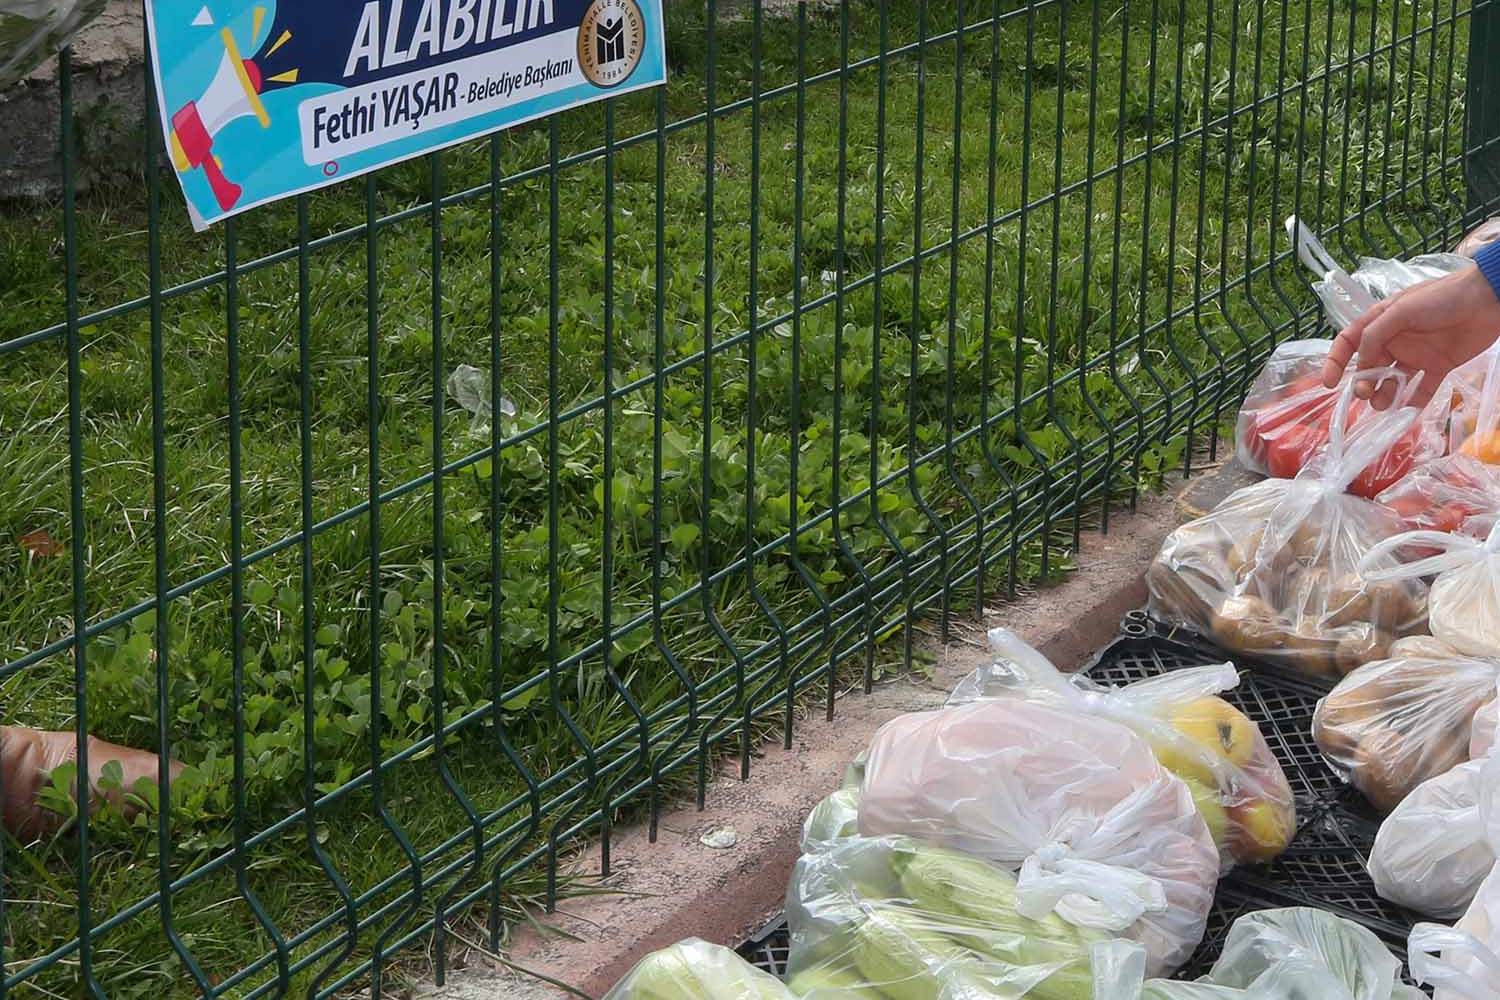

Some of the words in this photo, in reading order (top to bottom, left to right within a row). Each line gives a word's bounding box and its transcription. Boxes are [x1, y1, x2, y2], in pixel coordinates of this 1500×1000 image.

[313, 99, 376, 149] Fethi
[382, 71, 460, 130] YAŞAR
[467, 75, 522, 104] Belediye
[524, 58, 573, 89] Başkanı
